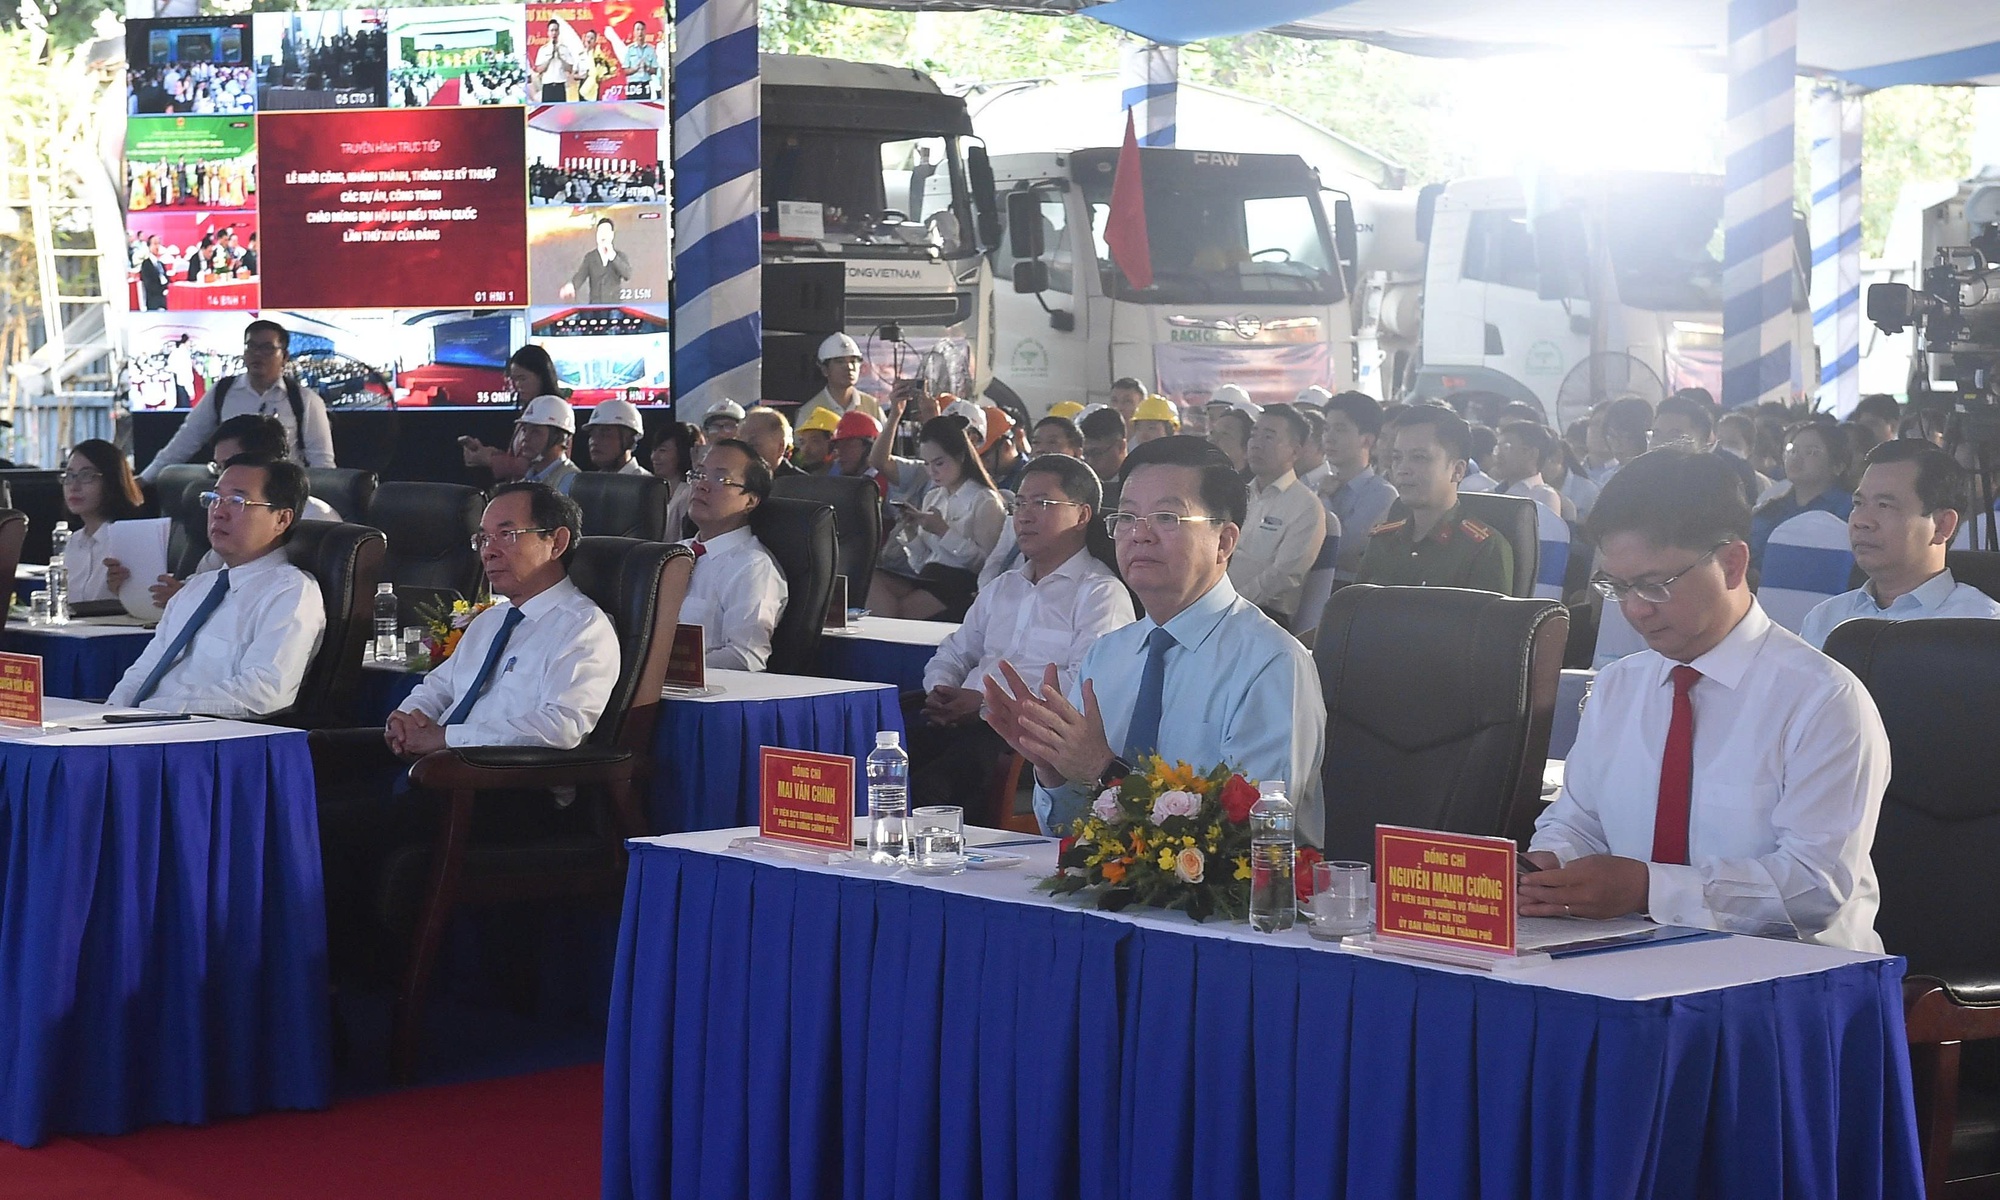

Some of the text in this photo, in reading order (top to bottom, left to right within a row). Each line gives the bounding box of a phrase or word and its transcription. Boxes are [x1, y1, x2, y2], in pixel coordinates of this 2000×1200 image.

[1194, 153, 1240, 166] FAW
[474, 291, 487, 302] 01
[508, 291, 514, 302] 1
[620, 289, 633, 300] 22
[777, 780, 836, 804] MAI VĂN CHÍNH
[1389, 862, 1503, 900] NGUYỄN MẠNH CƯỜNG
